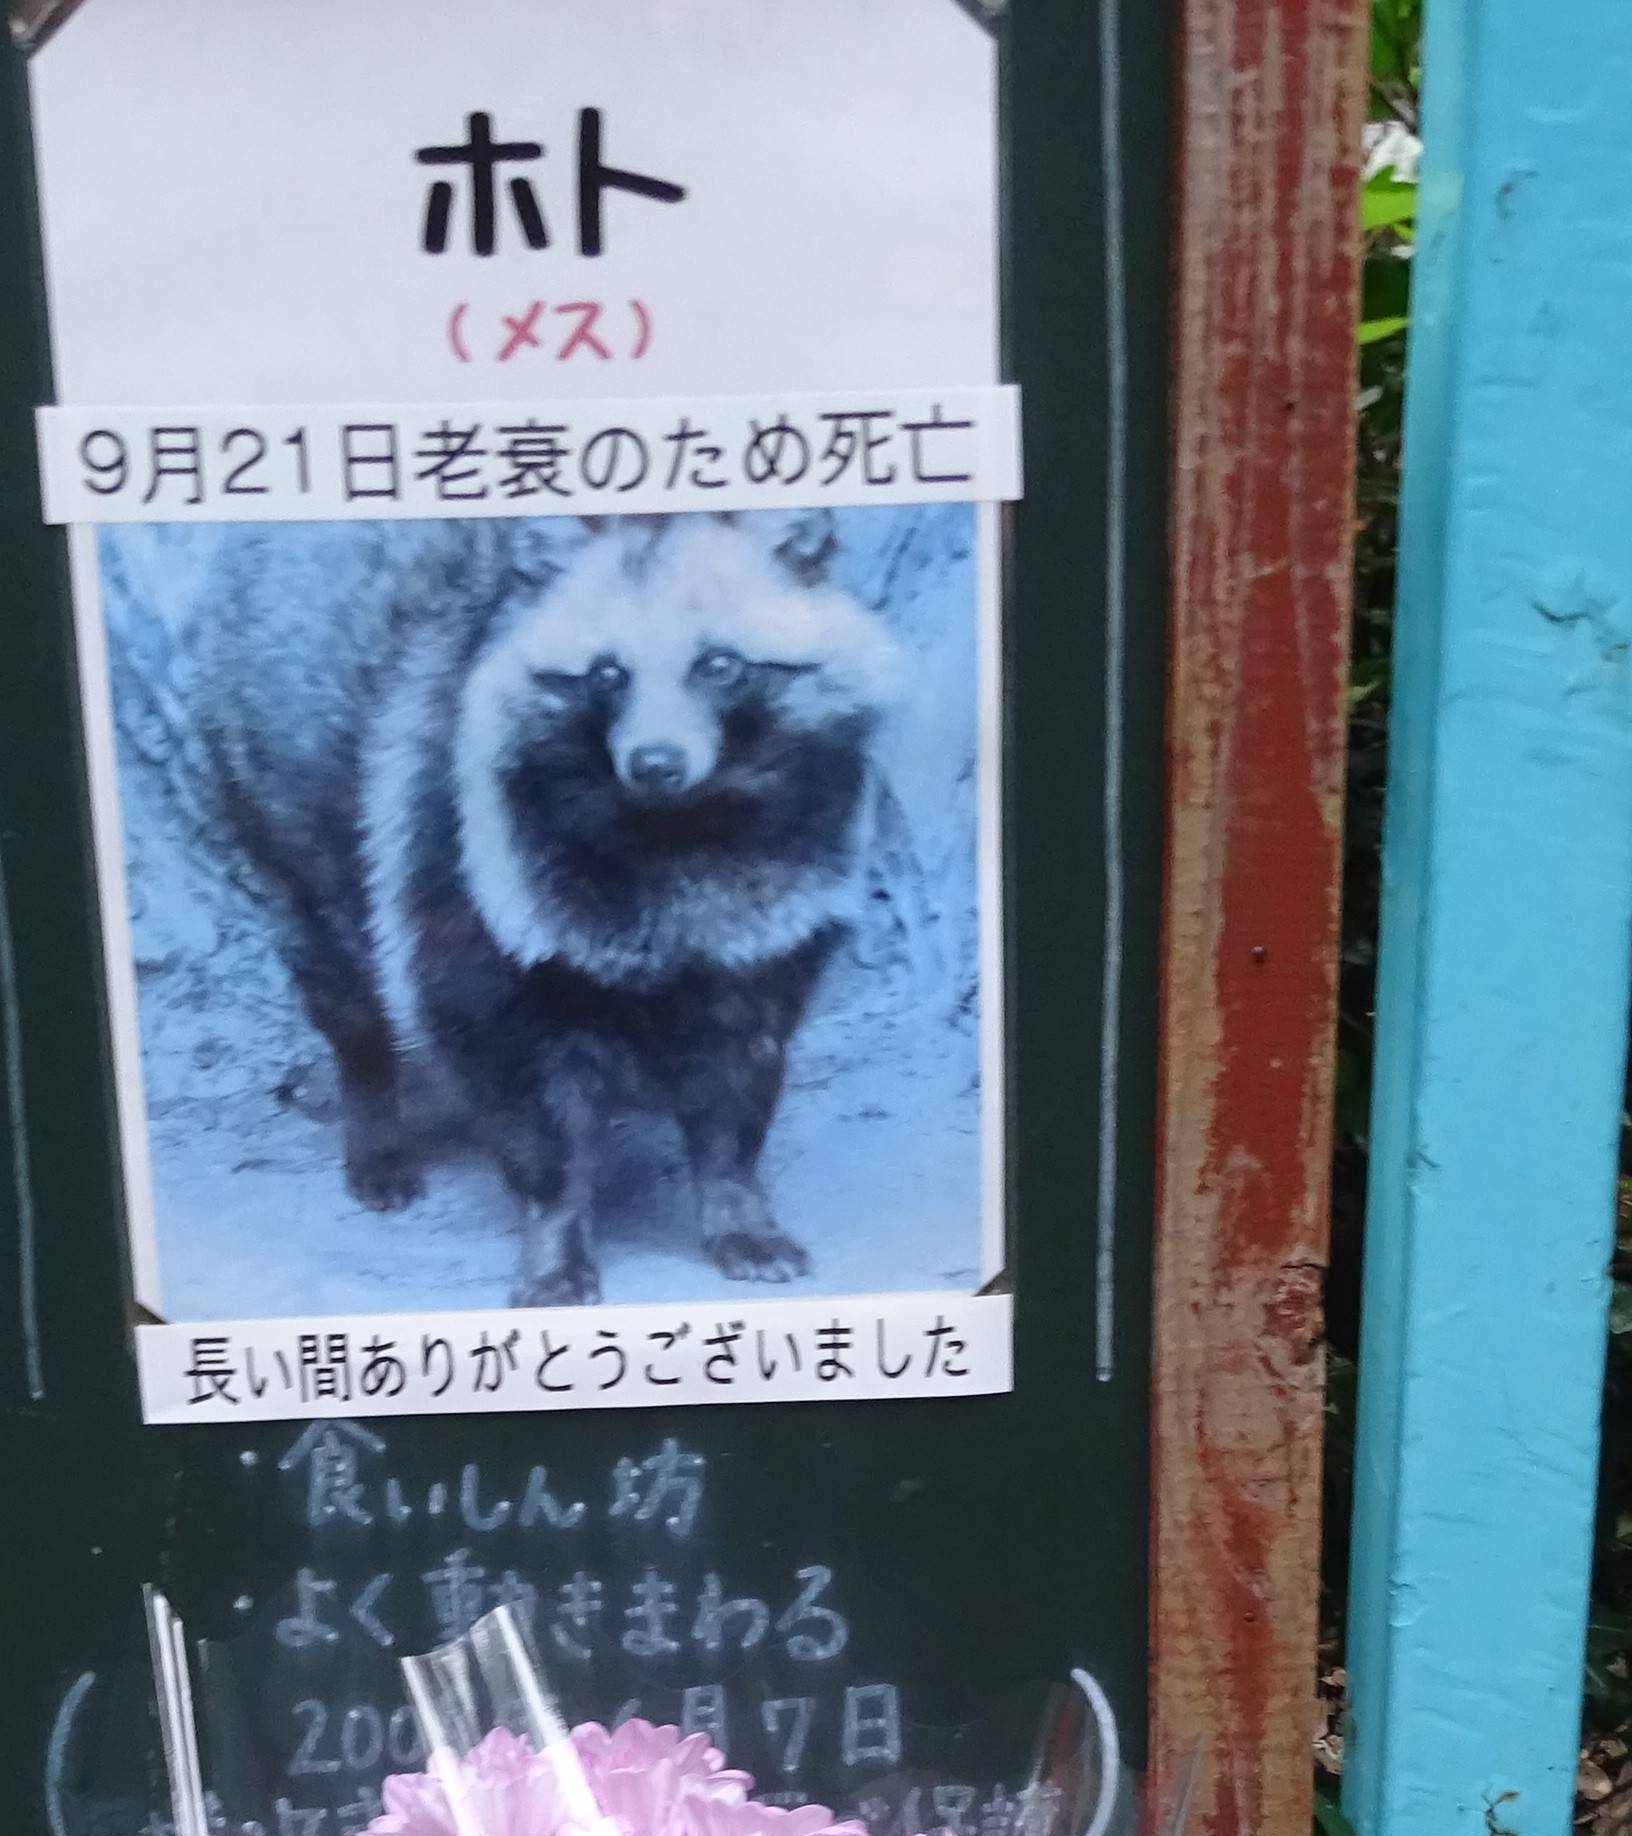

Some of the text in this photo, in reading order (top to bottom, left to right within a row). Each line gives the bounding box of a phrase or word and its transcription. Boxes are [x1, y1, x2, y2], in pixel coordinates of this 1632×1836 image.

[414, 106, 688, 258] ホト
[448, 300, 654, 363] (メス)
[78, 404, 977, 506] 9月21日老衰のため死亡
[182, 1313, 972, 1406] 長い間ありがとうございました
